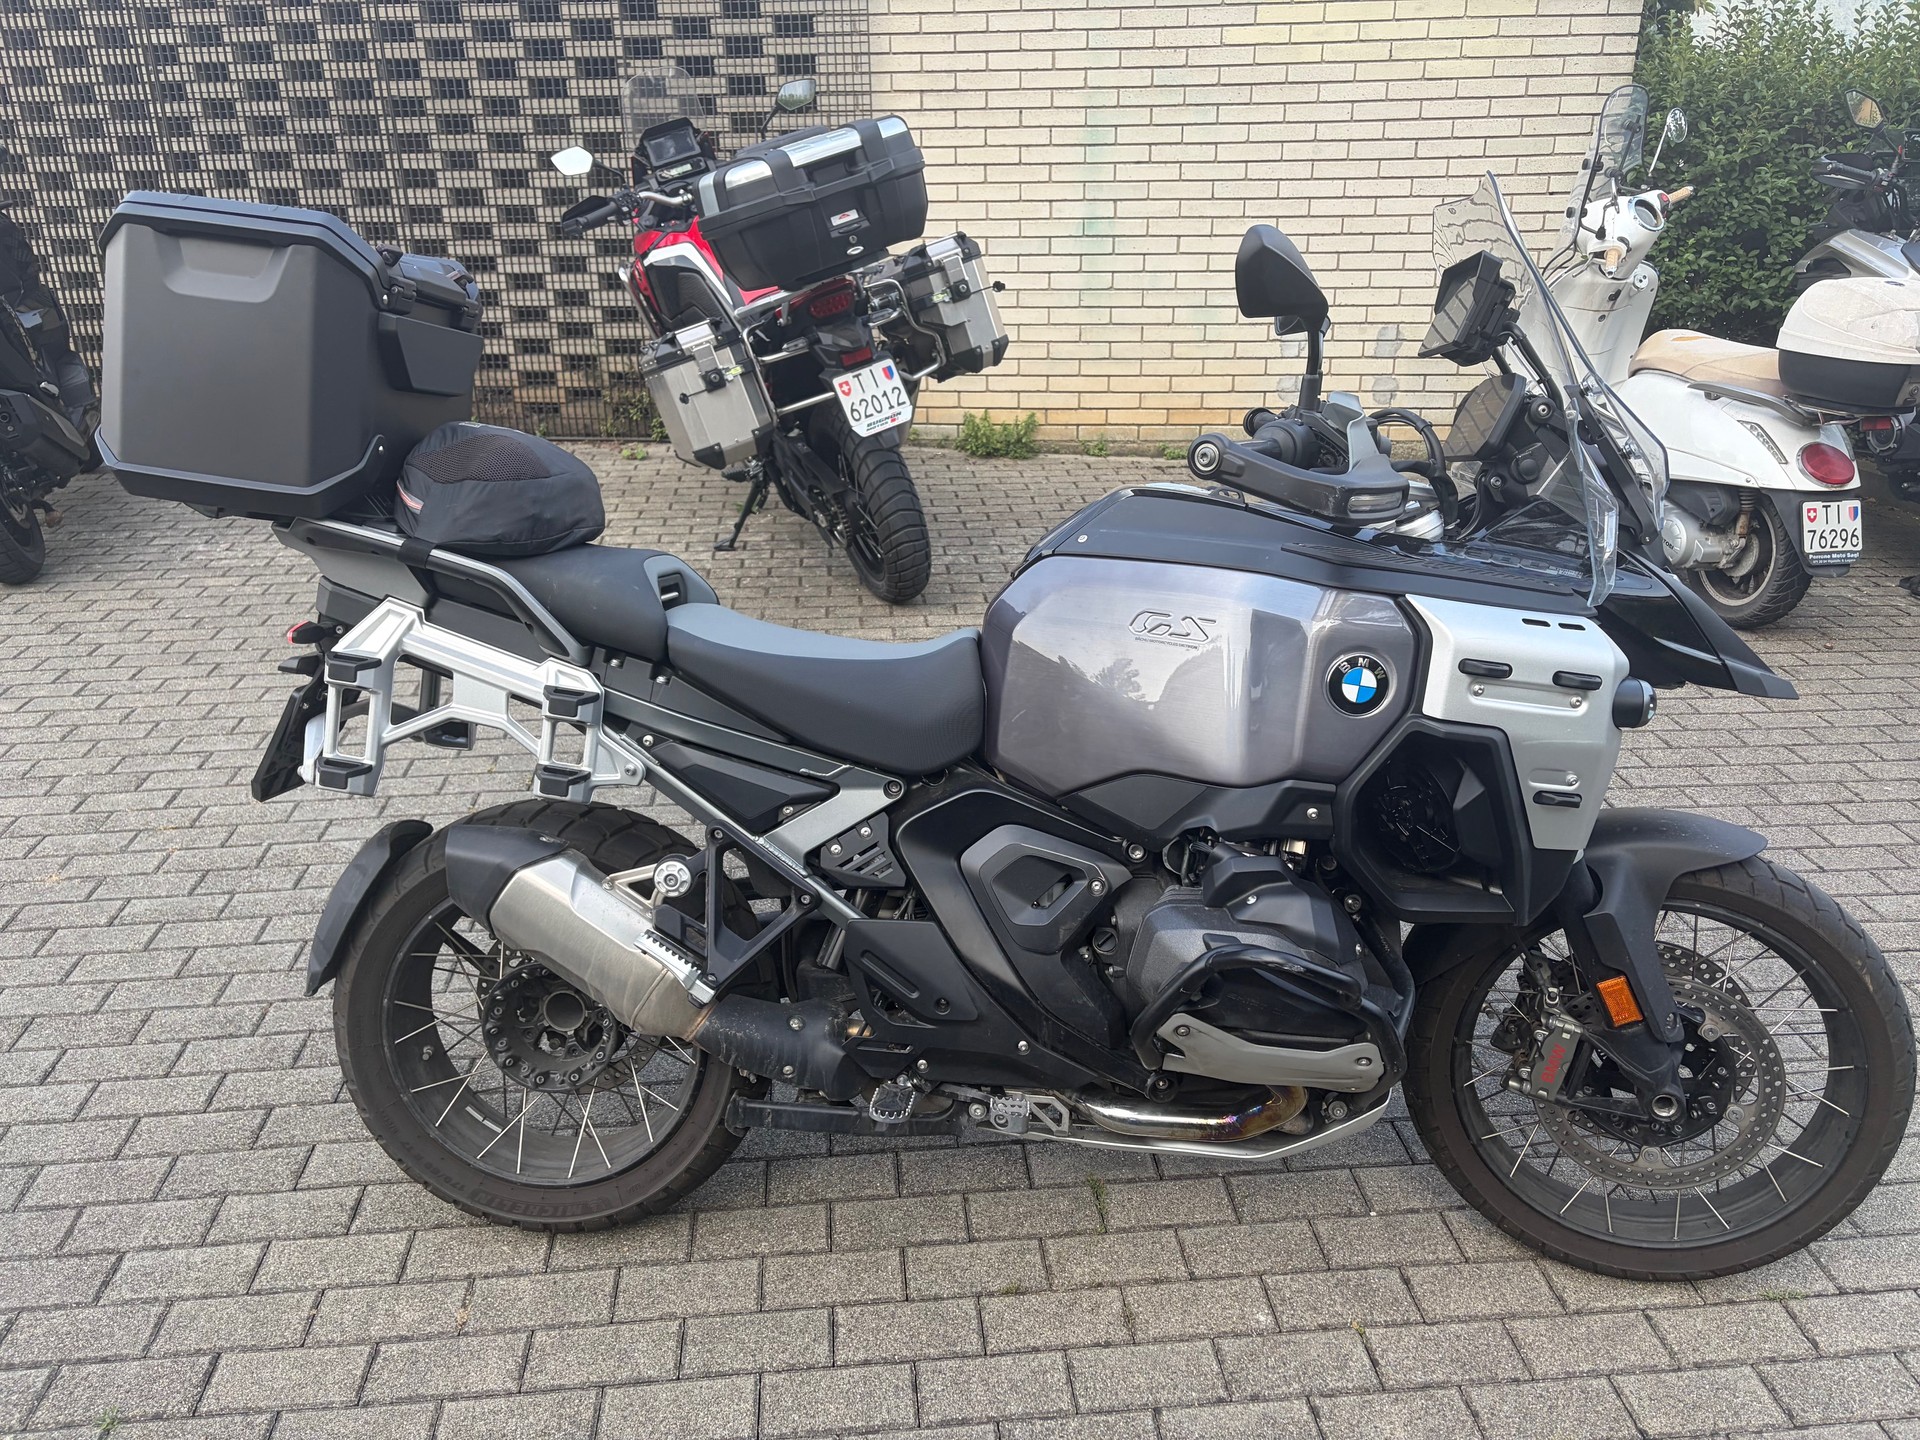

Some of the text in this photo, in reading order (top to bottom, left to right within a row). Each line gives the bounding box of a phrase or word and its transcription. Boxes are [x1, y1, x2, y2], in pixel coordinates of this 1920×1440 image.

[853, 369, 879, 393] TI
[850, 387, 906, 422] 62012
[1822, 504, 1841, 525] TI
[1807, 527, 1860, 550] 76296
[1128, 608, 1217, 643] GS
[1338, 657, 1386, 680] BMW
[1541, 1043, 1567, 1084] BMW
[475, 1191, 583, 1217] MICHELIN
